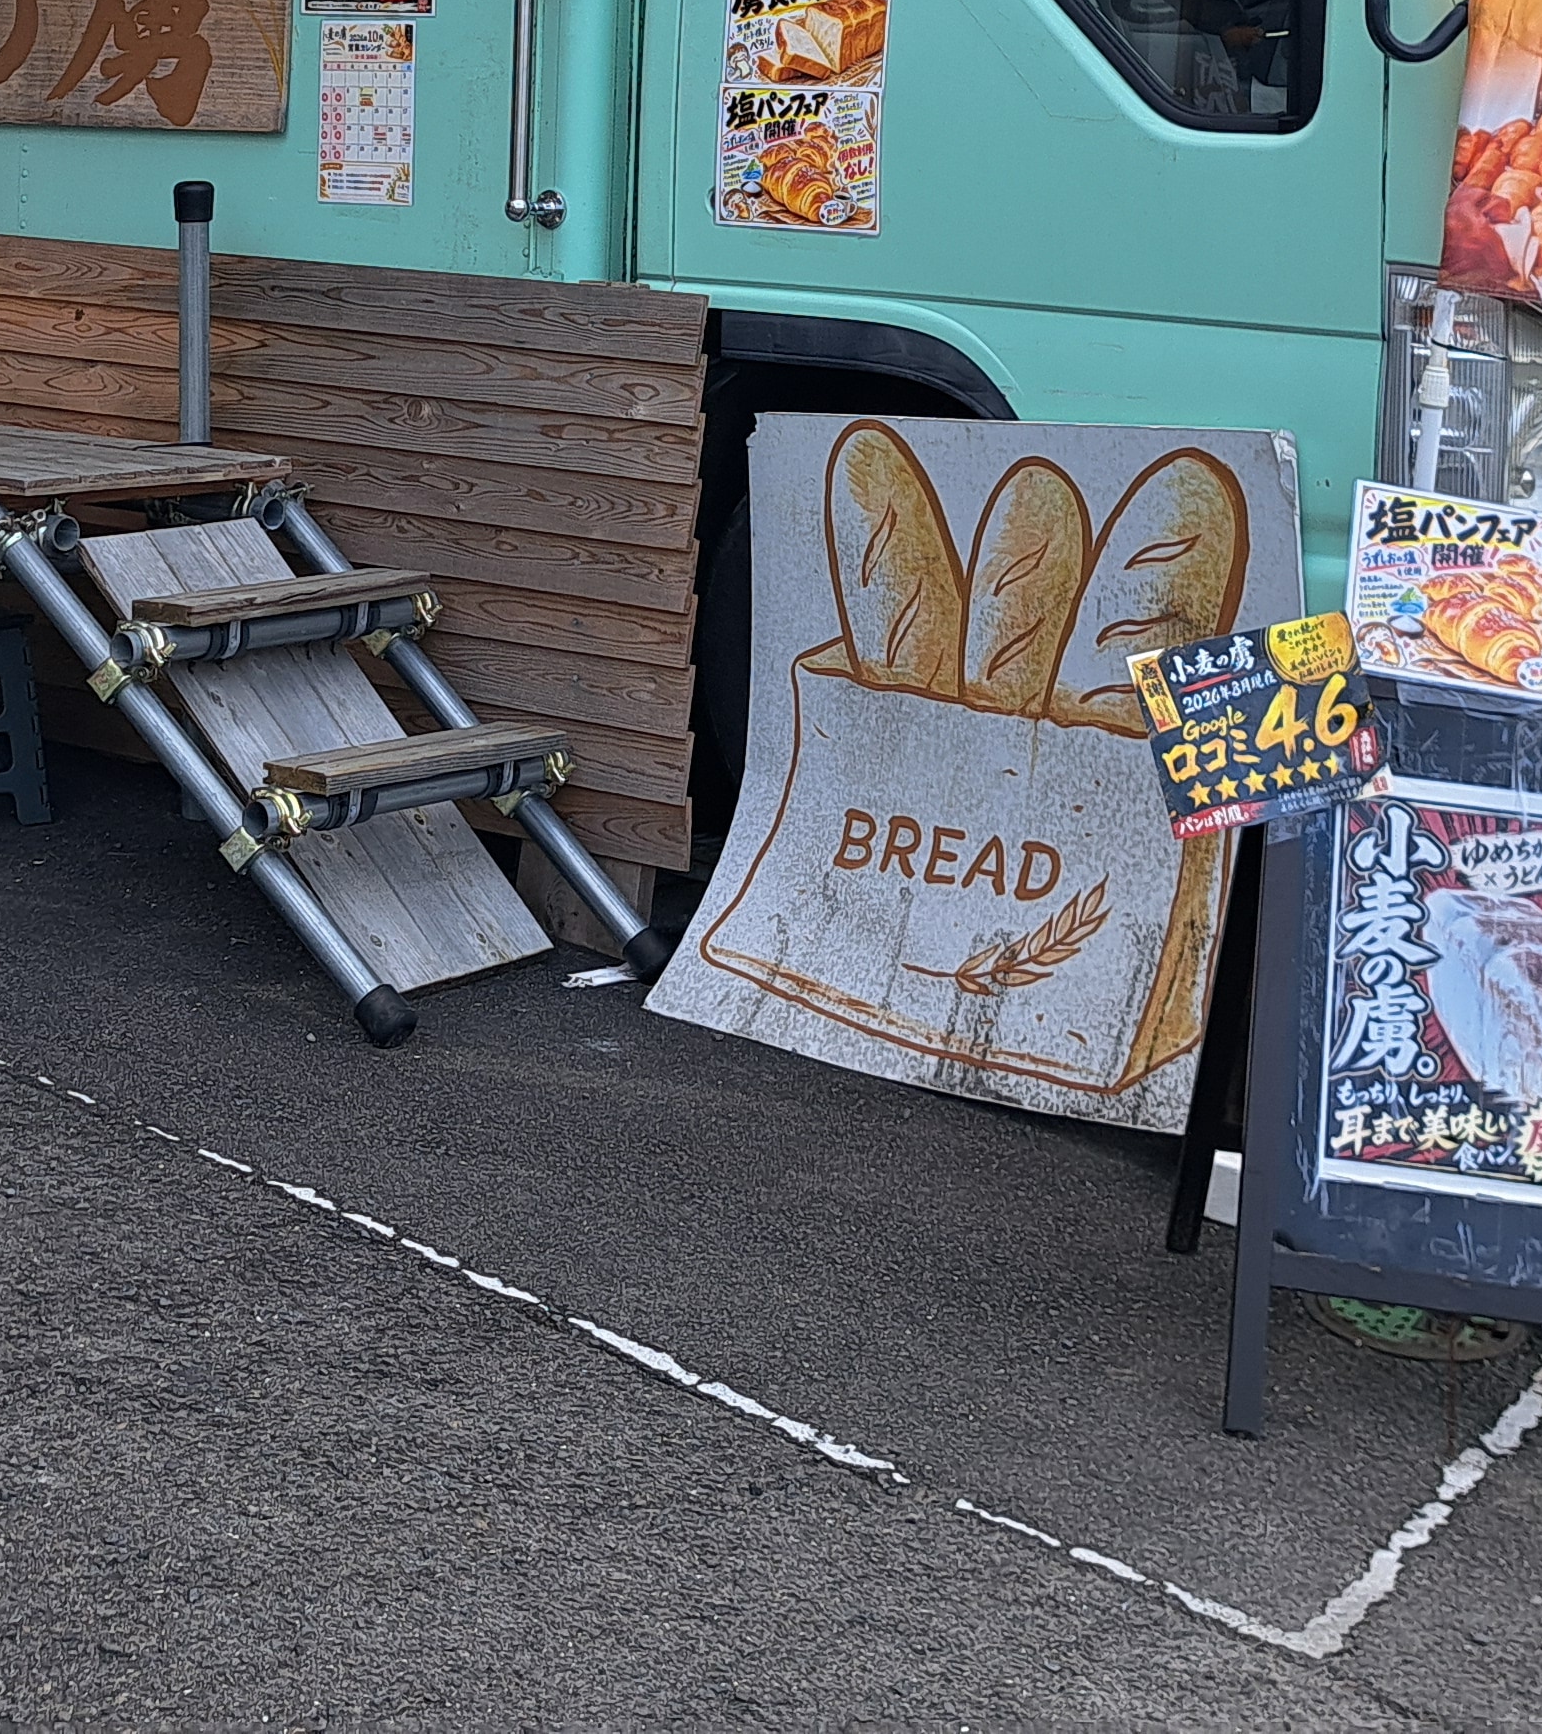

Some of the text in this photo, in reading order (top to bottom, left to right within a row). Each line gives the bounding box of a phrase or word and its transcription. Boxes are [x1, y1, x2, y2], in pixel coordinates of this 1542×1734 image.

[726, 91, 829, 129] 塩パンフェア
[764, 117, 806, 141] 開催!
[844, 156, 875, 180] なし!
[1366, 497, 1537, 546] 塩パンフェア
[1431, 543, 1500, 568] 開催!
[1169, 635, 1255, 683] 小麦の虜
[1162, 729, 1260, 783] 口コミ
[1255, 673, 1358, 761] 4.6
[1182, 705, 1248, 741] Google
[1178, 803, 1250, 835] パンは別腹。
[833, 806, 1063, 901] BREAD
[1332, 804, 1444, 1077] 小麦の虜。
[1336, 1080, 1470, 1107] もっちり、しっとり、
[1331, 1104, 1516, 1155] 耳まで美味しい
[1453, 1141, 1516, 1170] 食パン。
